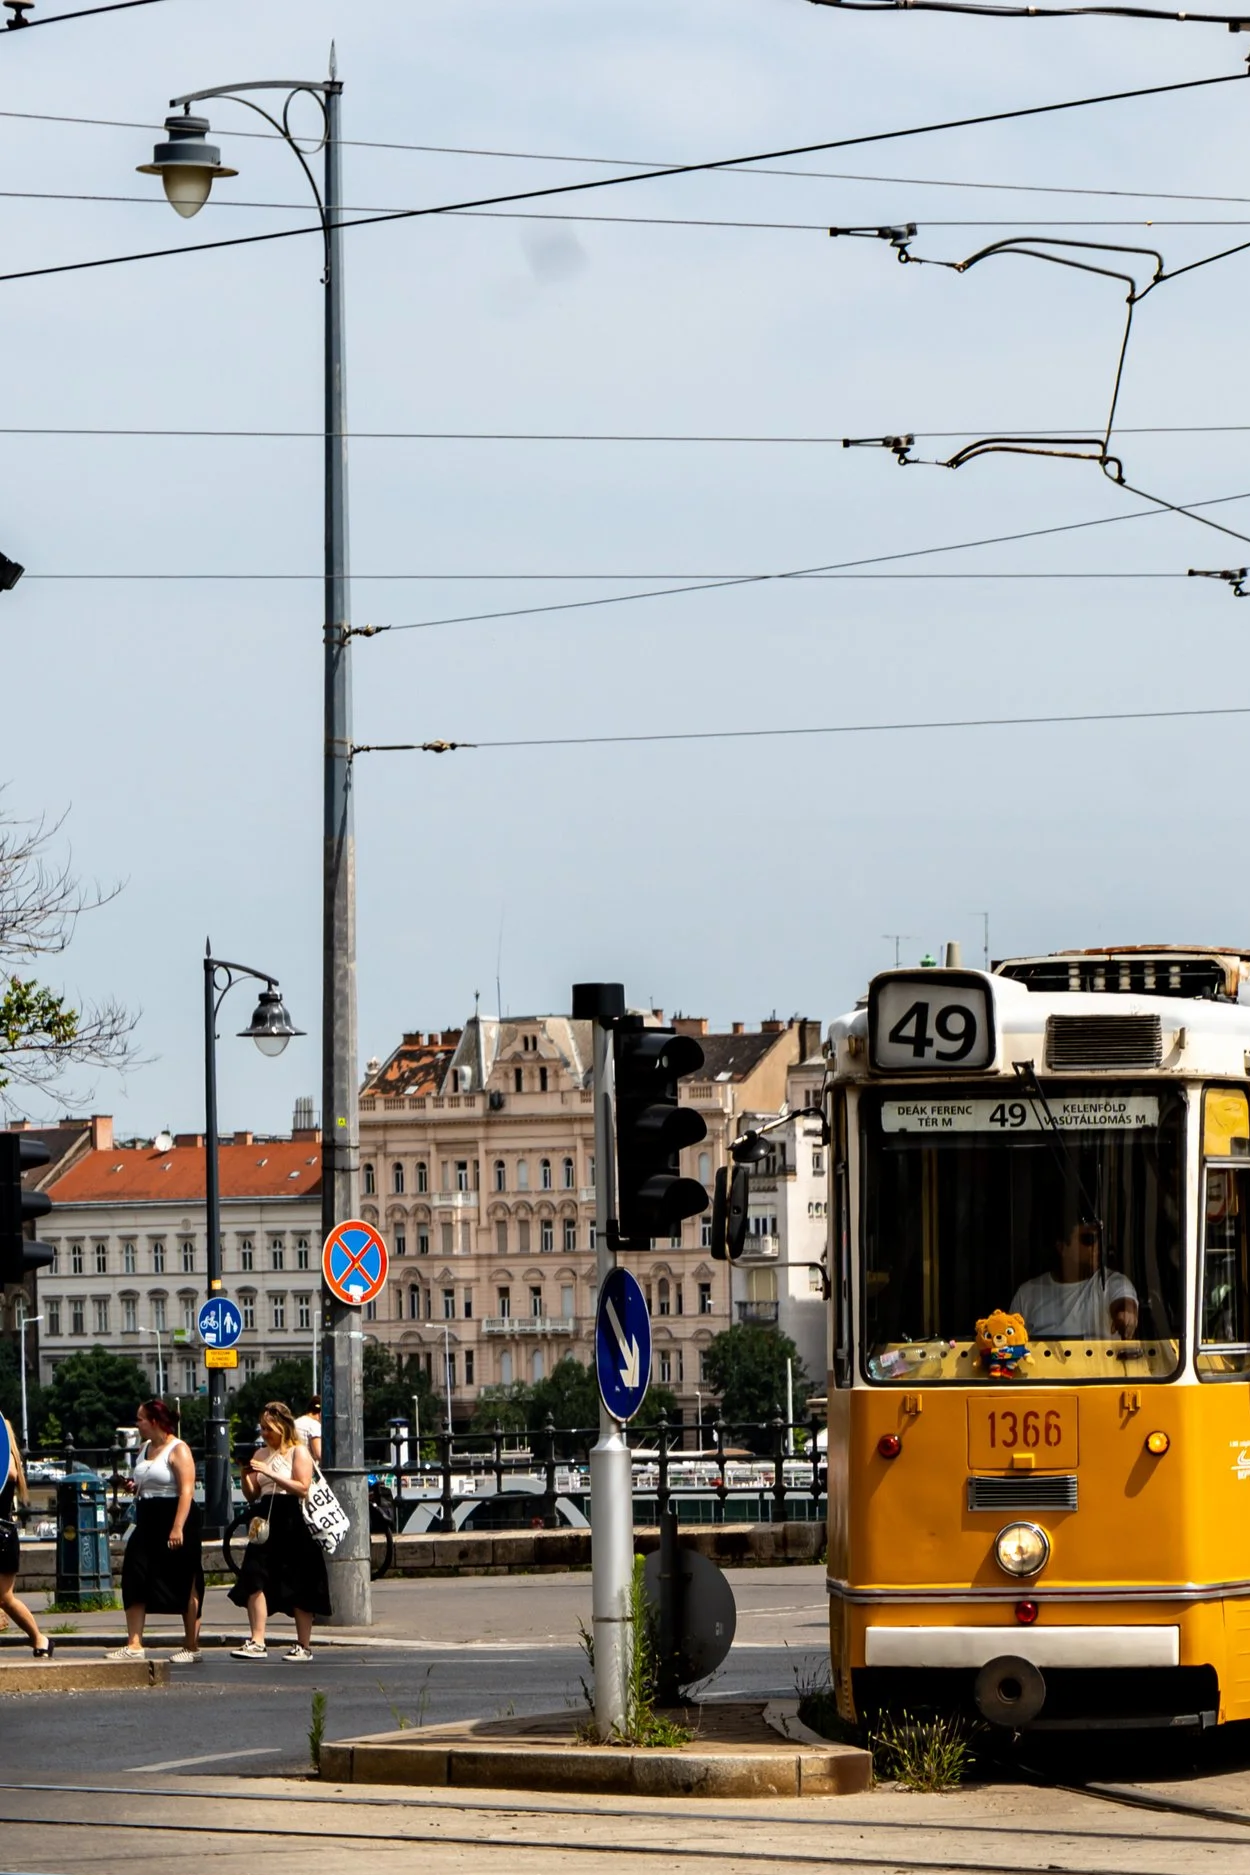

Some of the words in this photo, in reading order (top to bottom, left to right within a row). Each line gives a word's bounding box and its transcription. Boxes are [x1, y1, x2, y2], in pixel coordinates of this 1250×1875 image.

[889, 1001, 977, 1062] 49
[897, 1105, 929, 1116] DEÁK
[931, 1105, 972, 1115] FERENC
[1063, 1102, 1127, 1114] KELENFÖLD
[918, 1116, 939, 1127] TÉR
[941, 1117, 953, 1127] M
[989, 1103, 1027, 1128] 49
[1134, 1114, 1147, 1125] M
[988, 1410, 1062, 1449] 1366
